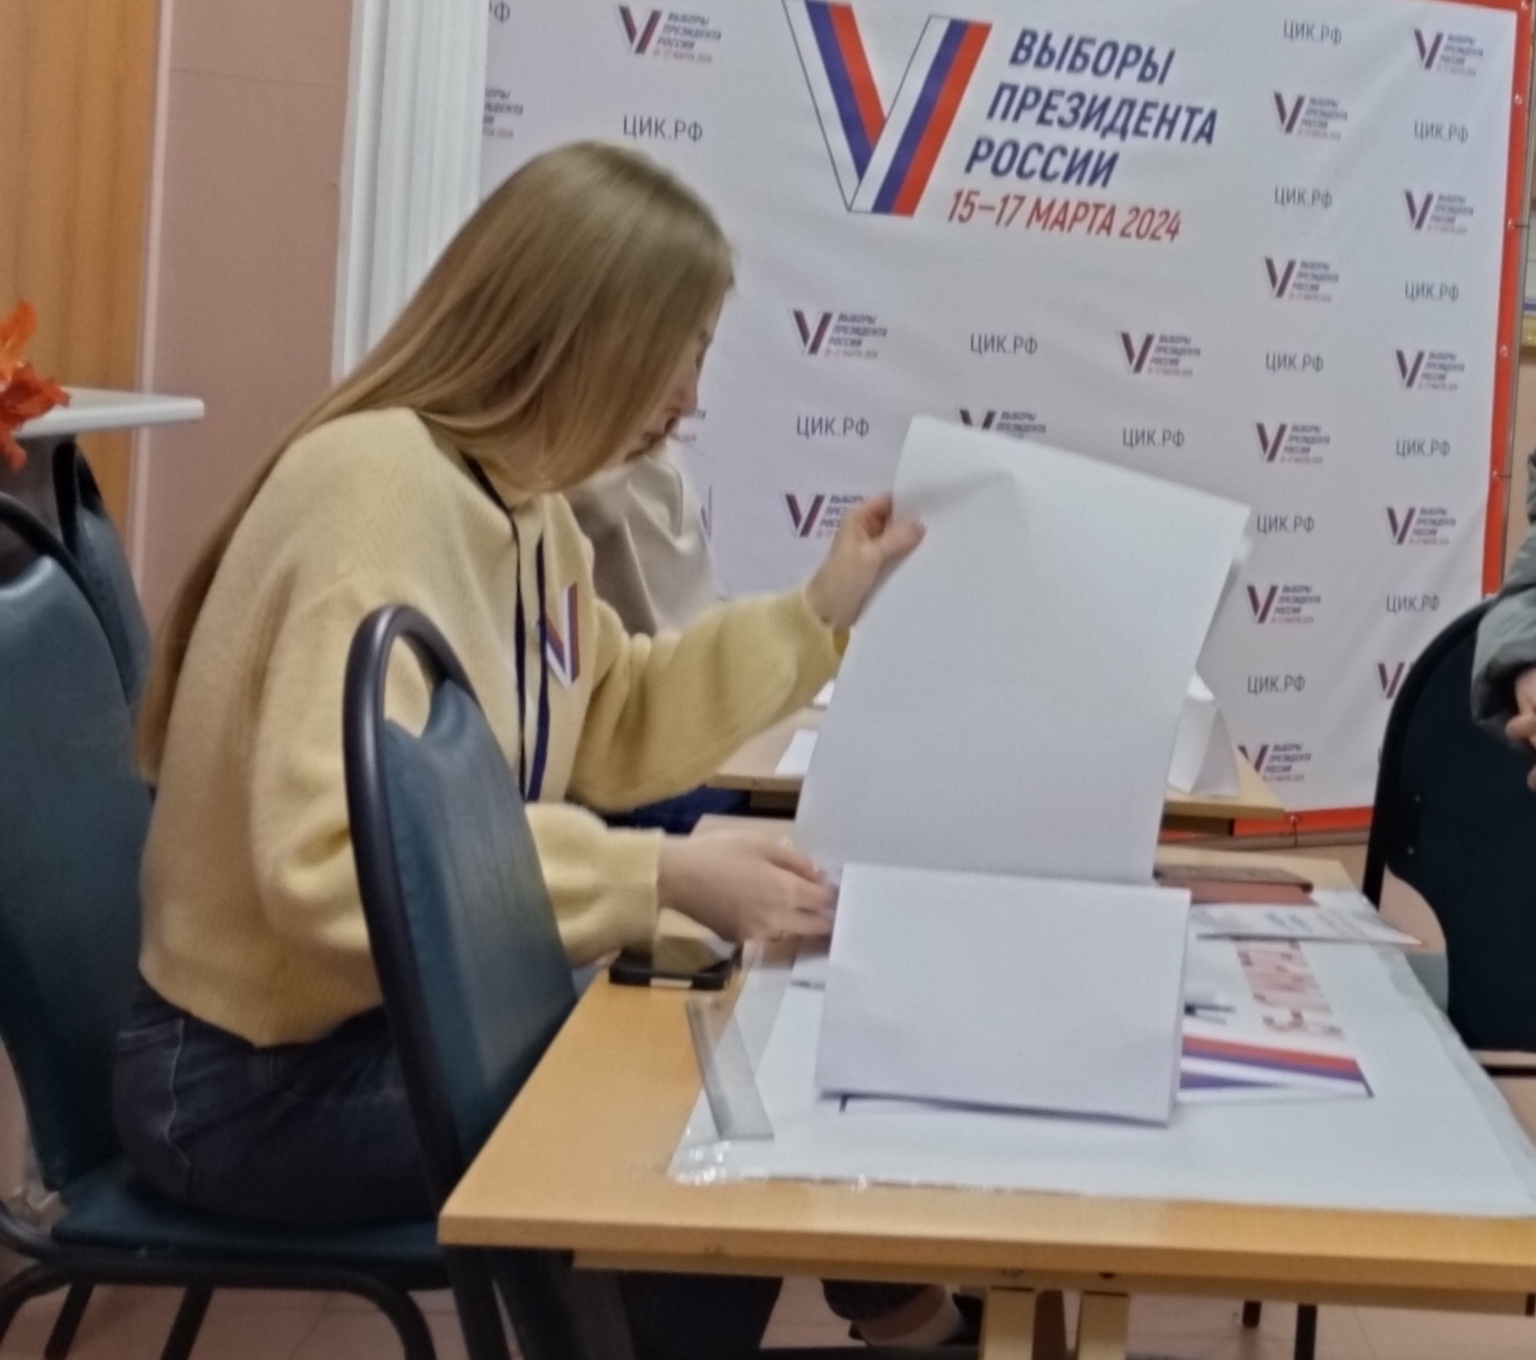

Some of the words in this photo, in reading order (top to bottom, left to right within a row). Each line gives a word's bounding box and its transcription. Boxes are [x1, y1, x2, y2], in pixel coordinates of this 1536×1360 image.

[1283, 20, 1342, 46] ЦИК.РФ
[1009, 27, 1176, 85] ВЫБОРЫ
[987, 83, 1219, 146] ПРЕЗИДЕНТА
[623, 114, 704, 143] ЦИК.РФ
[1413, 121, 1469, 144] ЦИК.РФ
[964, 135, 1120, 189] РОССИИ
[1274, 186, 1333, 209] ЦИК.РФ
[1026, 196, 1117, 238] МАРТА
[1118, 206, 1182, 243] 2024
[1404, 281, 1460, 303] ЦИК.РФ
[970, 333, 1038, 355] ЦИК.РФ
[1265, 352, 1324, 373] ЦИК.РФ
[796, 416, 870, 439] ЦИК.РФ
[1122, 428, 1185, 449] ЦИК.РФ
[1395, 439, 1451, 460] ЦИК.РФ
[1256, 514, 1315, 536] ЦИК.РФ
[1385, 593, 1440, 614] ЦИК.РФ
[1246, 674, 1306, 695] ЦИК.РФ
